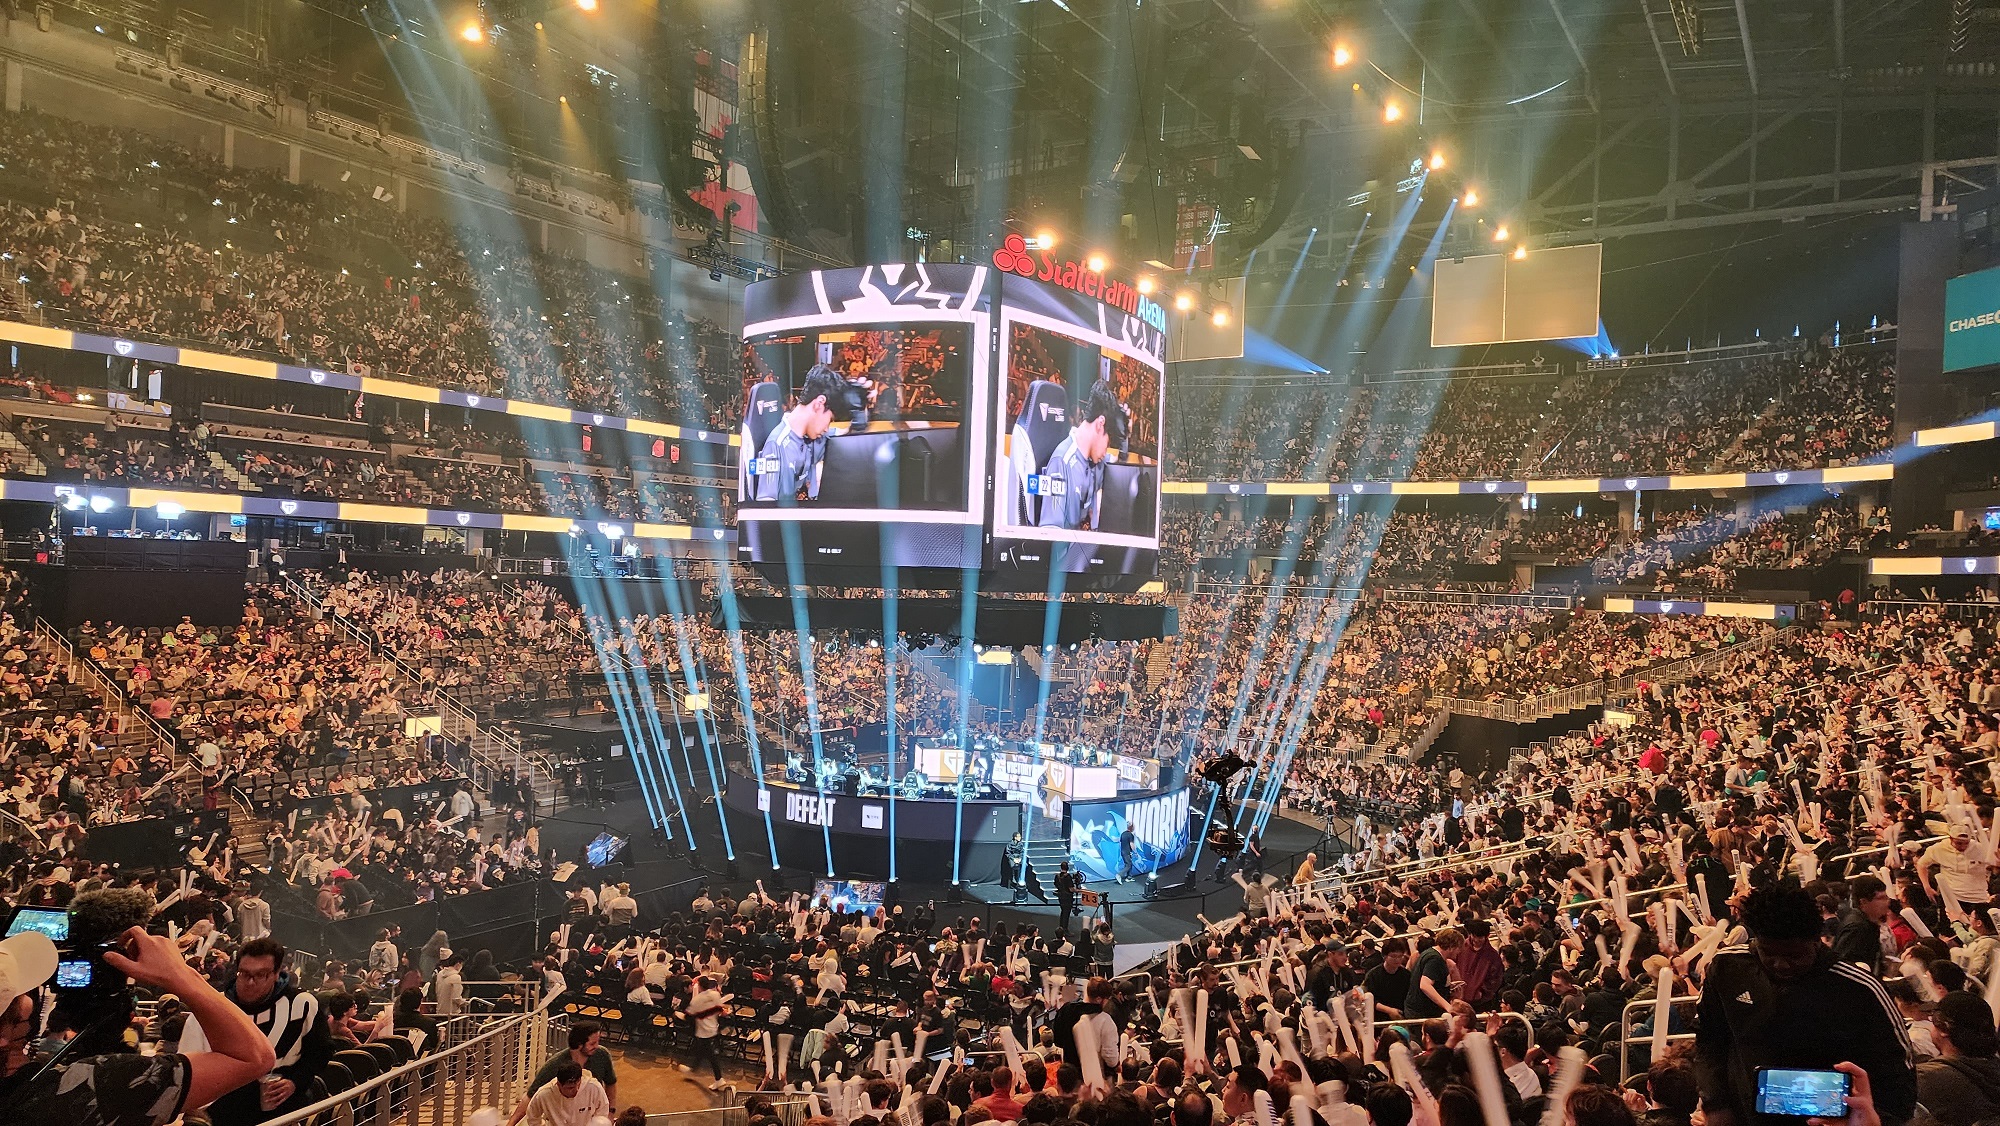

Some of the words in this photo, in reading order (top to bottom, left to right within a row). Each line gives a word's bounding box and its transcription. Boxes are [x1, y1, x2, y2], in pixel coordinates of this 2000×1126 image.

[786, 791, 837, 827] DEFEAT
[1082, 893, 1090, 903] FL
[1092, 895, 1098, 904] 3
